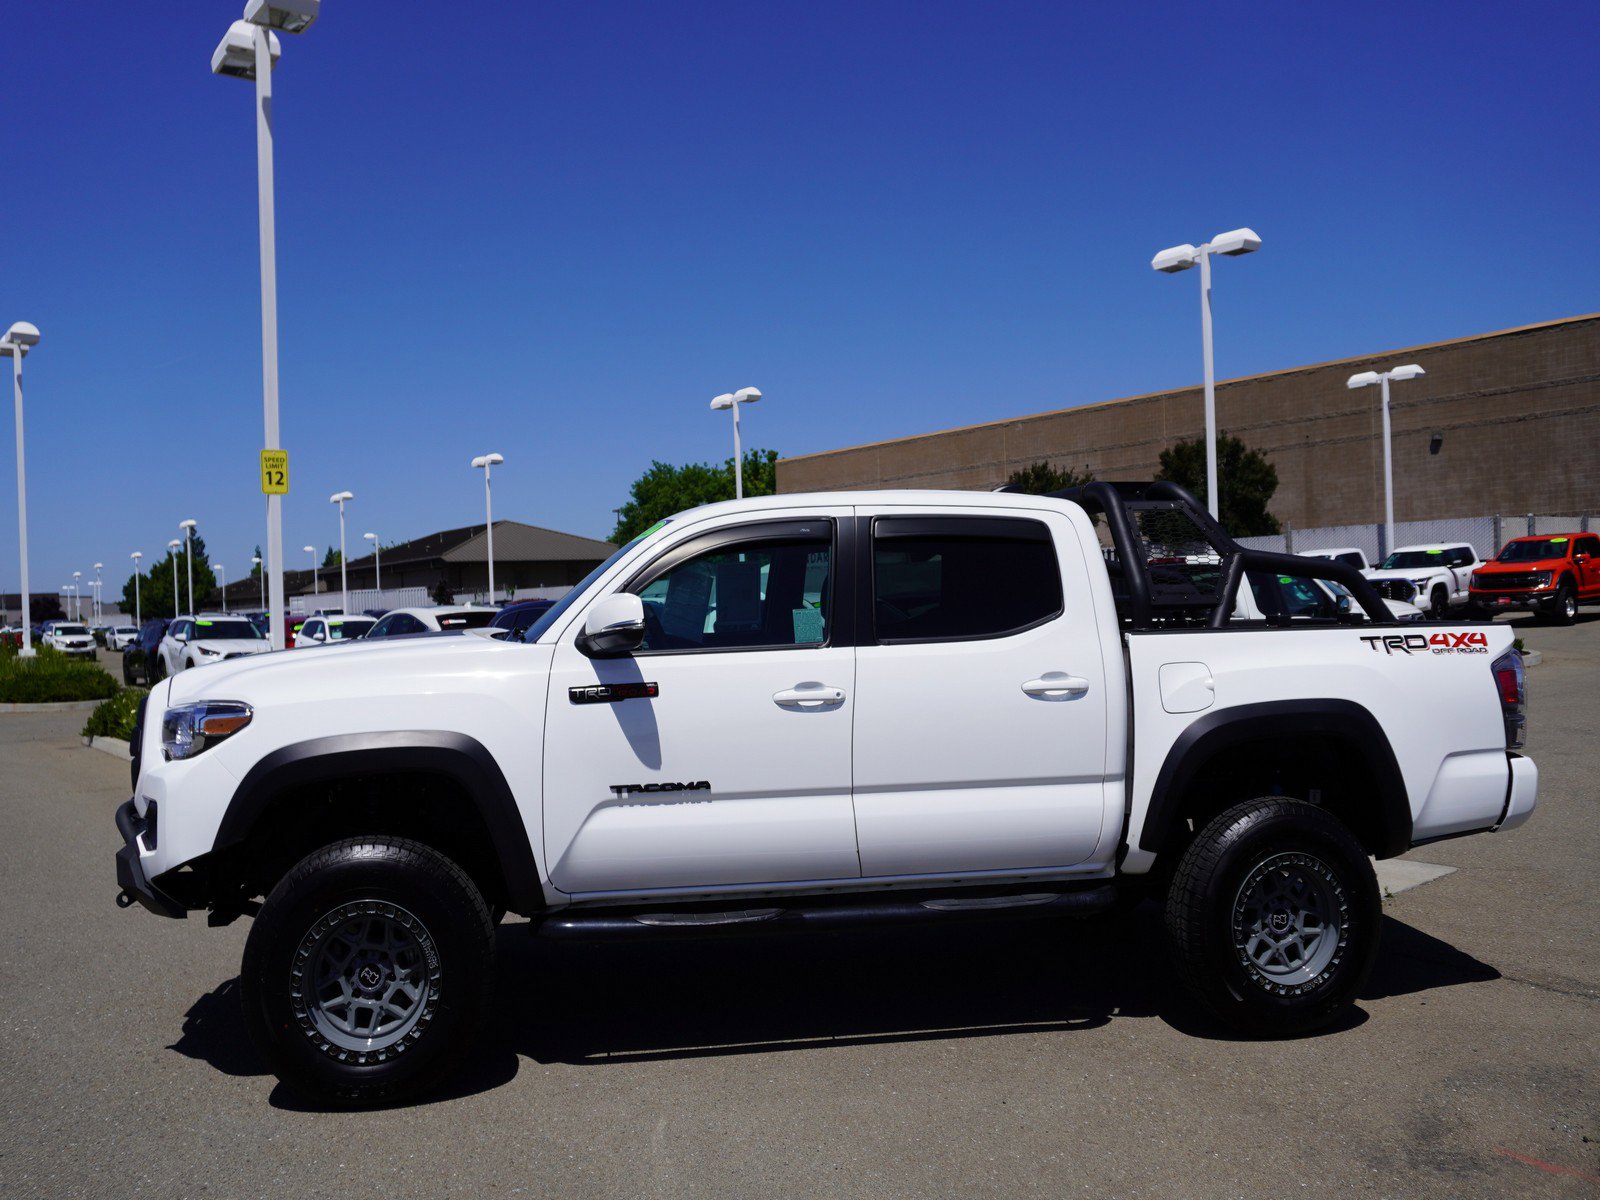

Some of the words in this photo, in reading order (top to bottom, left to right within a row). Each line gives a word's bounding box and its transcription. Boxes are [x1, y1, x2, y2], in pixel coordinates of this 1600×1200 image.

[265, 471, 284, 486] 12
[1359, 635, 1428, 656] TRD
[1428, 632, 1489, 648] 4X4
[1431, 647, 1455, 655] OFF
[1456, 647, 1488, 655] ROAD
[571, 686, 611, 700] TRD
[609, 780, 711, 794] TACOMA
